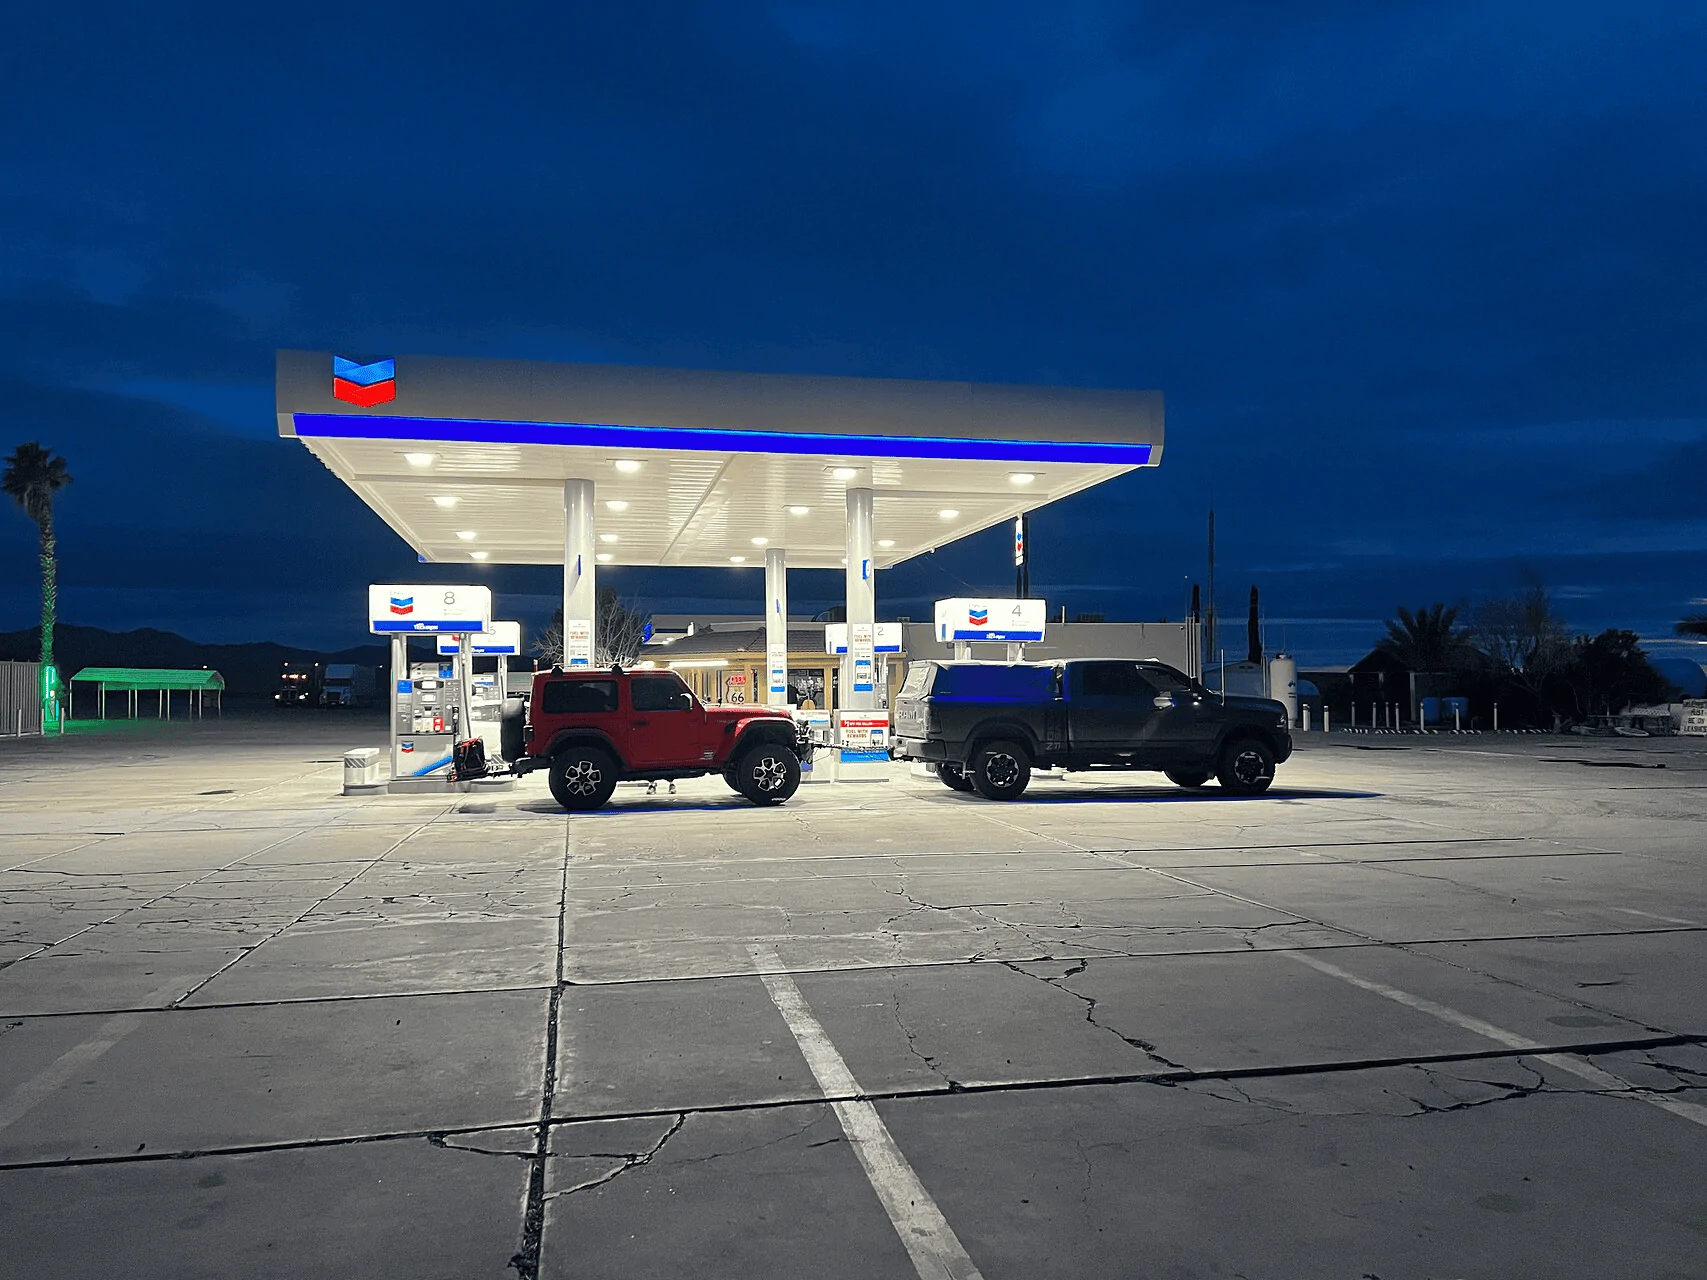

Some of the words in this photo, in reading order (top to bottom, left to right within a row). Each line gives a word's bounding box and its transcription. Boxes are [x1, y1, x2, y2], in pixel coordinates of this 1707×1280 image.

[444, 591, 455, 605] 8
[1011, 604, 1022, 617] 4
[877, 626, 885, 636] 2
[731, 692, 745, 703] 66
[899, 710, 917, 720] RAM
